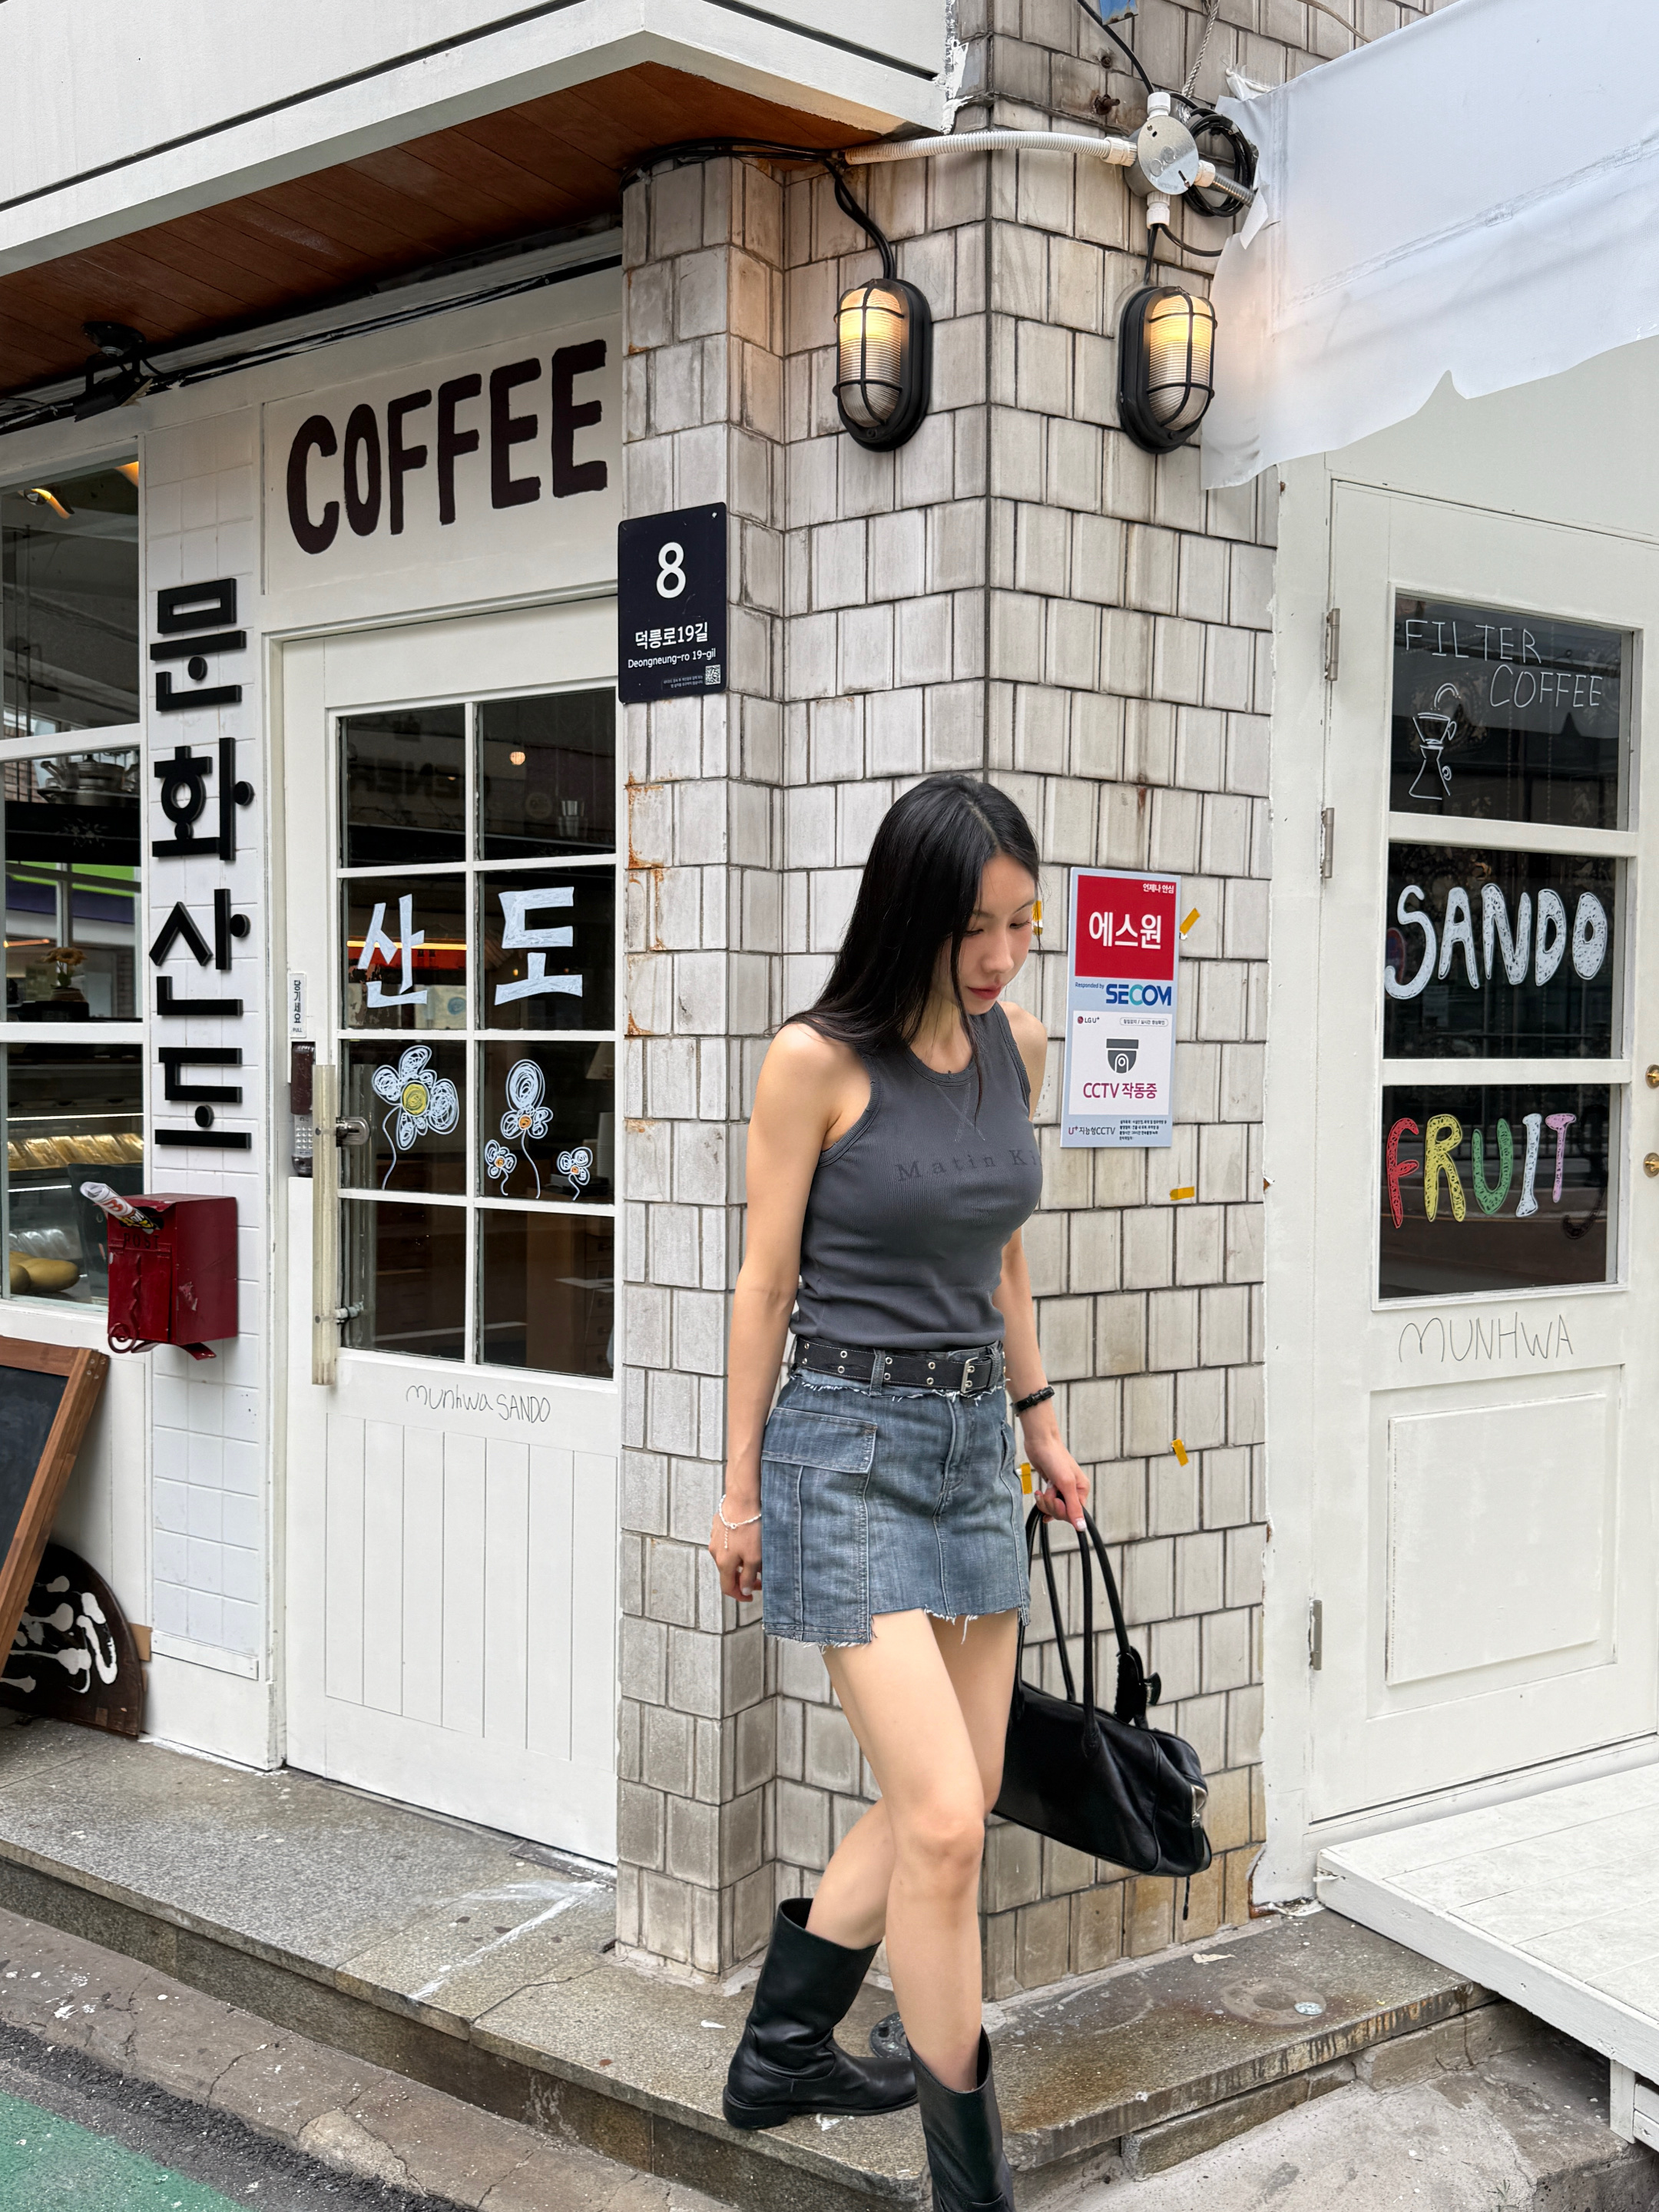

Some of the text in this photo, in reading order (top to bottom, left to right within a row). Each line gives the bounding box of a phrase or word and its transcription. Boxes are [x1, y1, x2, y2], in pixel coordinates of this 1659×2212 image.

[286, 339, 608, 555] COFFEE
[656, 541, 686, 598] 8
[635, 622, 708, 650] 덕릉로19길
[1406, 619, 1541, 664] FILTER
[628, 647, 716, 668] Deongneung-ro 19-gil
[1490, 664, 1603, 707] COFFEE
[1161, 885, 1174, 894] 안심
[1089, 912, 1161, 949] 에스원
[1384, 882, 1608, 999] SANDO
[1106, 984, 1172, 1005] SECOM
[1083, 1082, 1157, 1099] CCTV 작동중
[895, 1154, 996, 1181] Matin
[123, 1233, 160, 1250] POST
[1399, 1312, 1573, 1362] MUNHWA
[497, 1394, 551, 1423] SANDO
